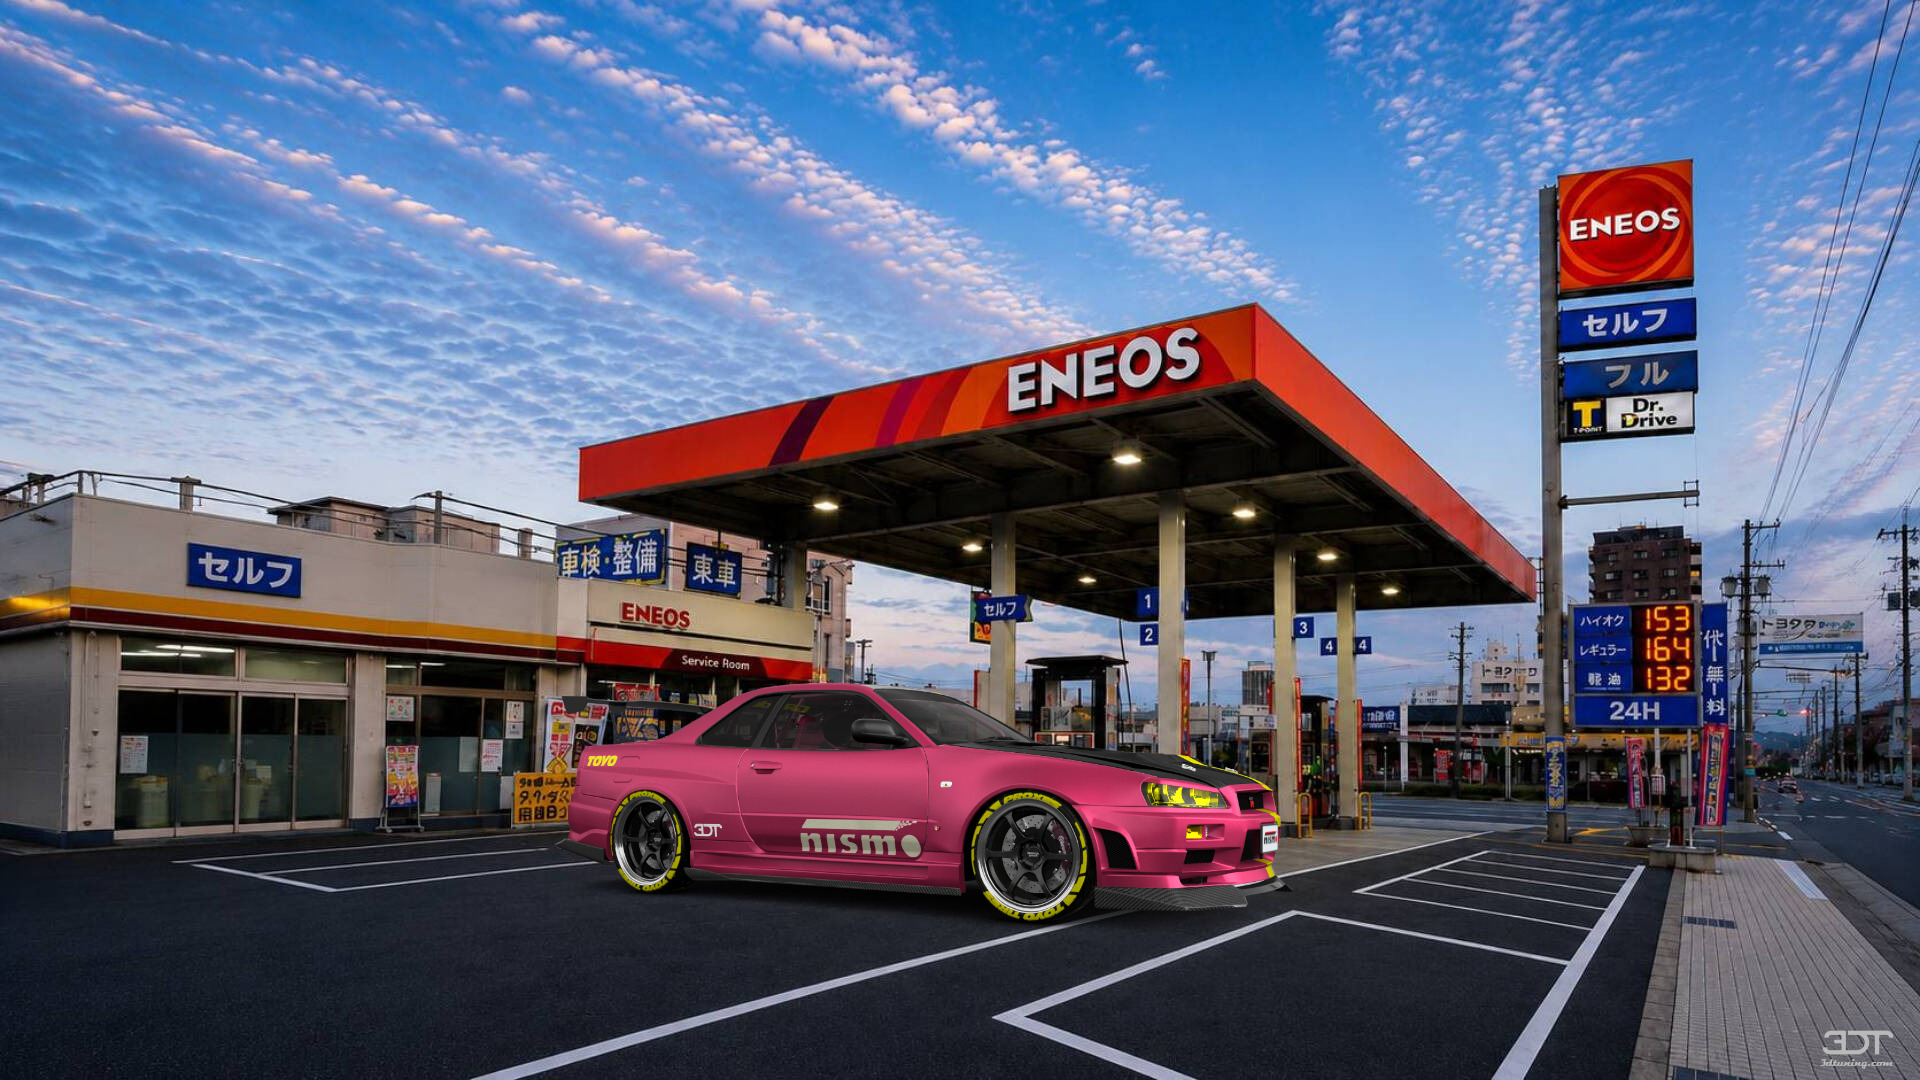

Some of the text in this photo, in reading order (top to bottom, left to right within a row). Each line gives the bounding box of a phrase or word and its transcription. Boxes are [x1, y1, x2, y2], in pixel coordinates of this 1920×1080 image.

[1570, 207, 1681, 241] ENEOS
[1582, 308, 1668, 337] セルフ
[1008, 327, 1201, 413] ENEOS
[1605, 361, 1670, 389] フル
[1633, 398, 1664, 413] Dr.
[1621, 413, 1678, 429] Drive
[560, 539, 658, 577] 車検・整備
[198, 552, 293, 588] セルフ
[983, 602, 1017, 617] セルフ
[1144, 594, 1152, 609] 1
[621, 602, 691, 629] ENEOS
[1580, 614, 1625, 627] ハイオク
[1645, 605, 1690, 632] 153
[1145, 627, 1153, 642] 2
[1299, 621, 1308, 634] 3
[1325, 640, 1333, 652] 4
[1359, 639, 1367, 651] 4
[1580, 644, 1627, 657] レギュラー
[1645, 636, 1690, 662] 164
[681, 655, 750, 671] Service Room
[1646, 666, 1690, 692] 132
[1609, 701, 1661, 721] 24H
[587, 755, 618, 767] TOYO
[693, 823, 723, 838] 3DT
[800, 832, 922, 858] nismo
[1022, 903, 1065, 921] TOYO
